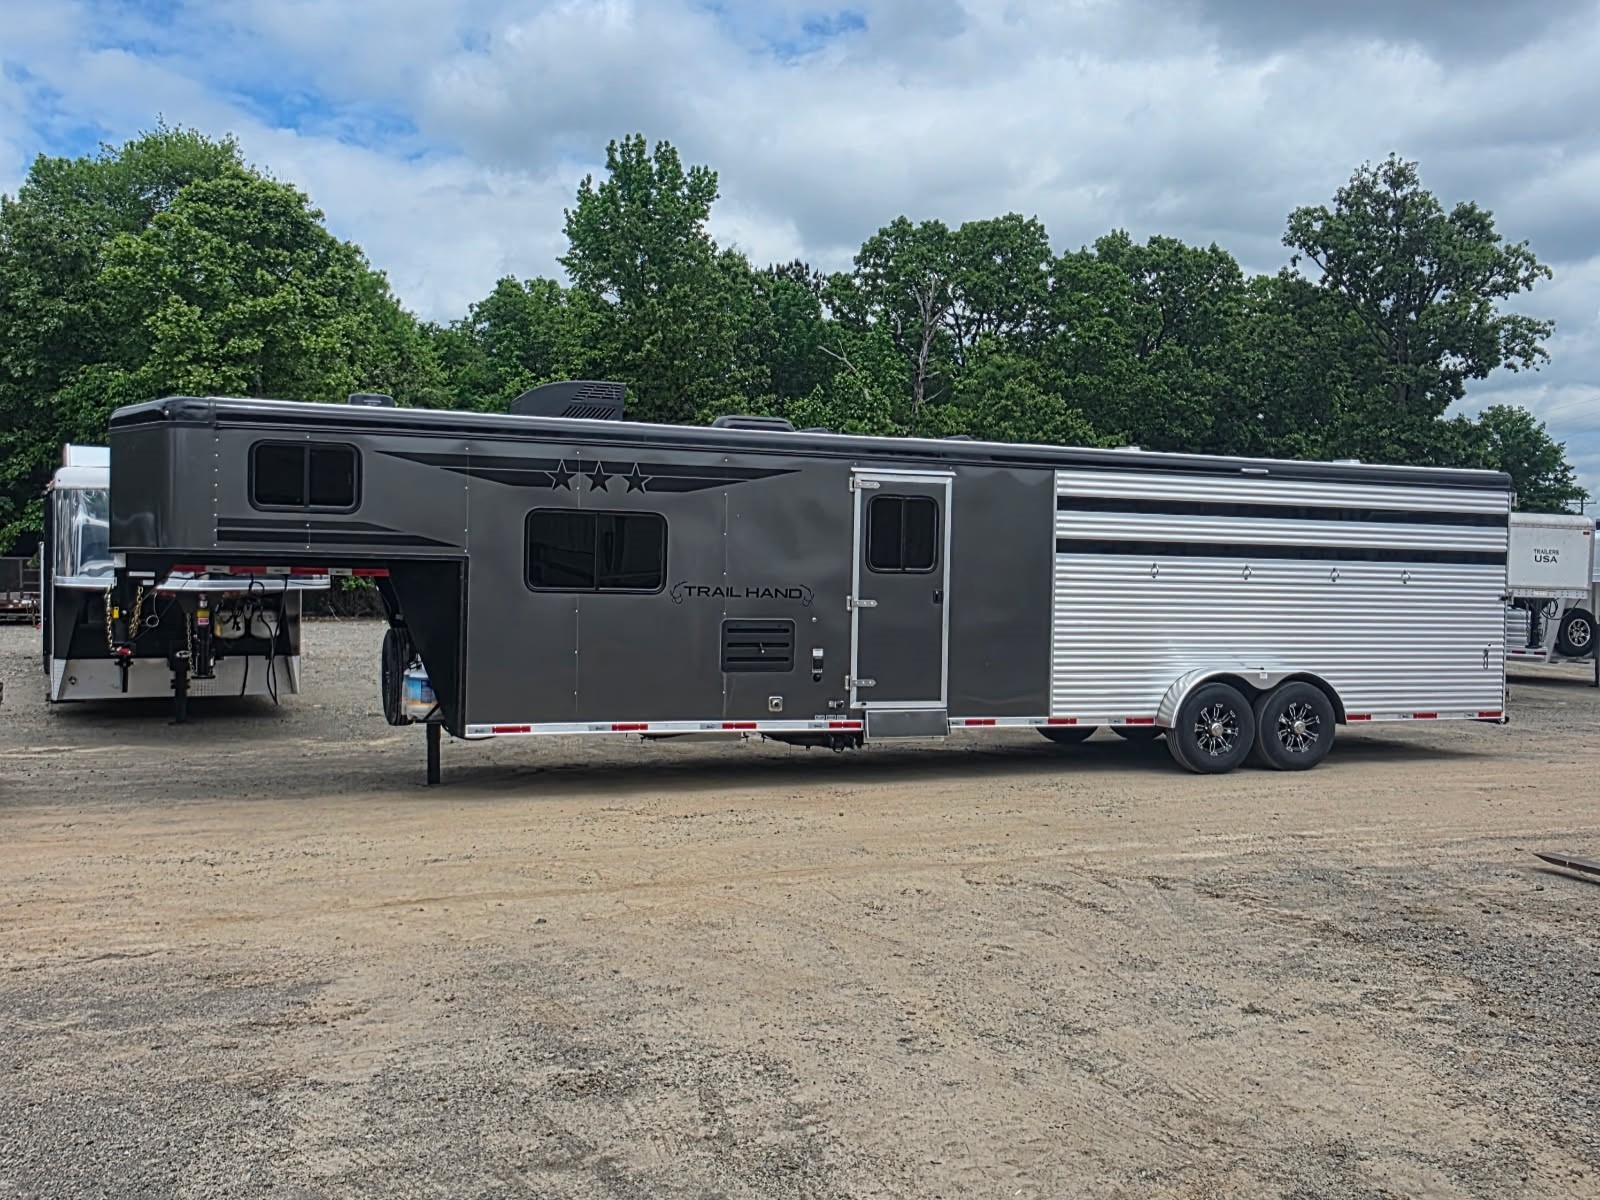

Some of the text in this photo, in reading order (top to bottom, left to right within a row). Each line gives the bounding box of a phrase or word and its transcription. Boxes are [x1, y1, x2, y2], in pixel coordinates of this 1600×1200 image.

[1535, 555, 1557, 563] USA
[684, 586, 802, 599] TRAIL HAND
